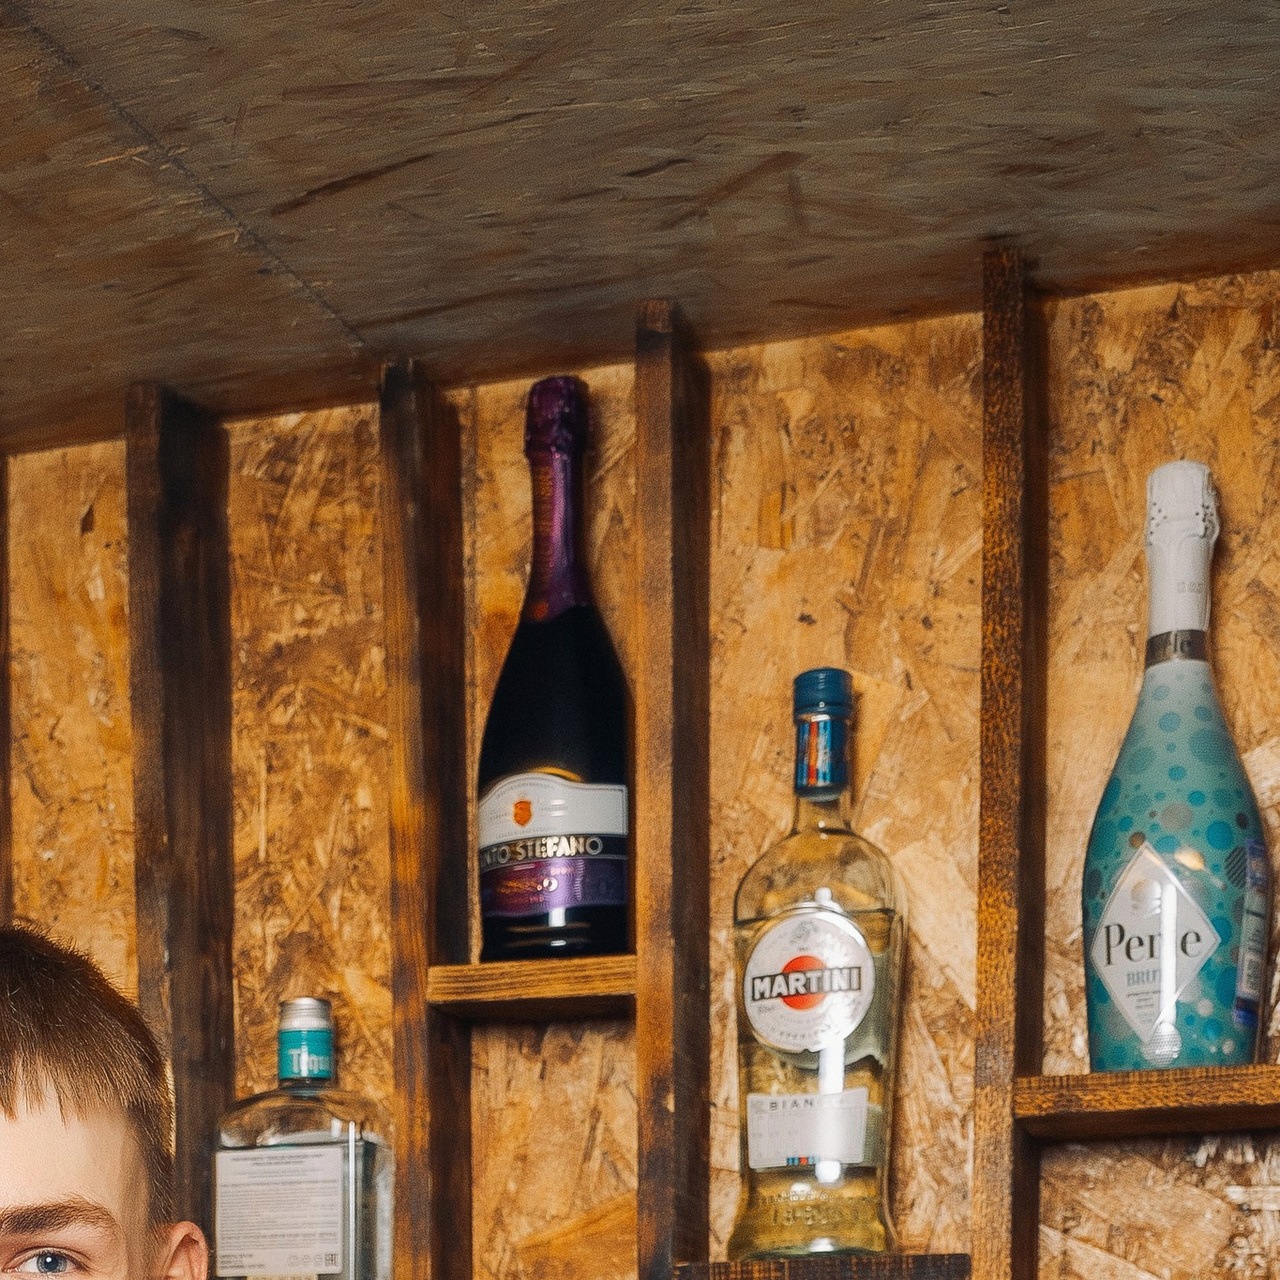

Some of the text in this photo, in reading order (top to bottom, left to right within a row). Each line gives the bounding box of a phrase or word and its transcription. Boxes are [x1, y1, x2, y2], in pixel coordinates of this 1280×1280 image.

[517, 836, 603, 861] STEFANO
[1104, 922, 1202, 967] Pere
[753, 966, 860, 1000] MARTINI
